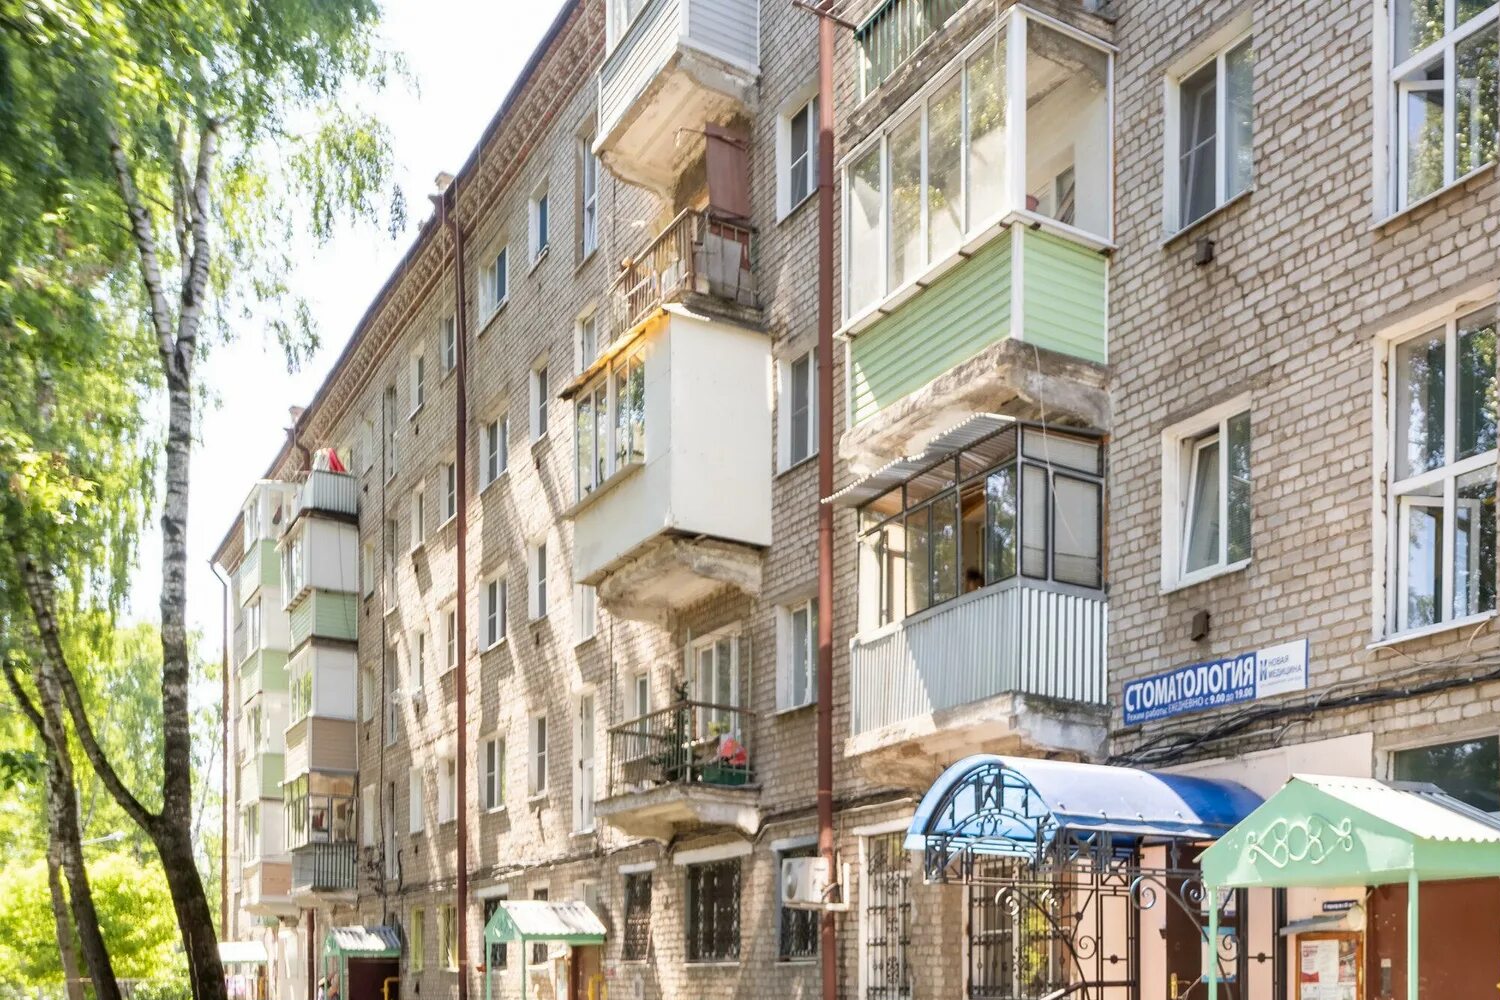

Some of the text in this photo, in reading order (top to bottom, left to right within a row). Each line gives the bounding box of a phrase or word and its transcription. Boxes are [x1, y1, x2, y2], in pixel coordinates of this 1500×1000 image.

[1268, 654, 1289, 667] НОВАЯ
[1268, 664, 1303, 679] МЕДИЦИНА
[1125, 656, 1254, 712] СТОМАТОЛОГИЯ
